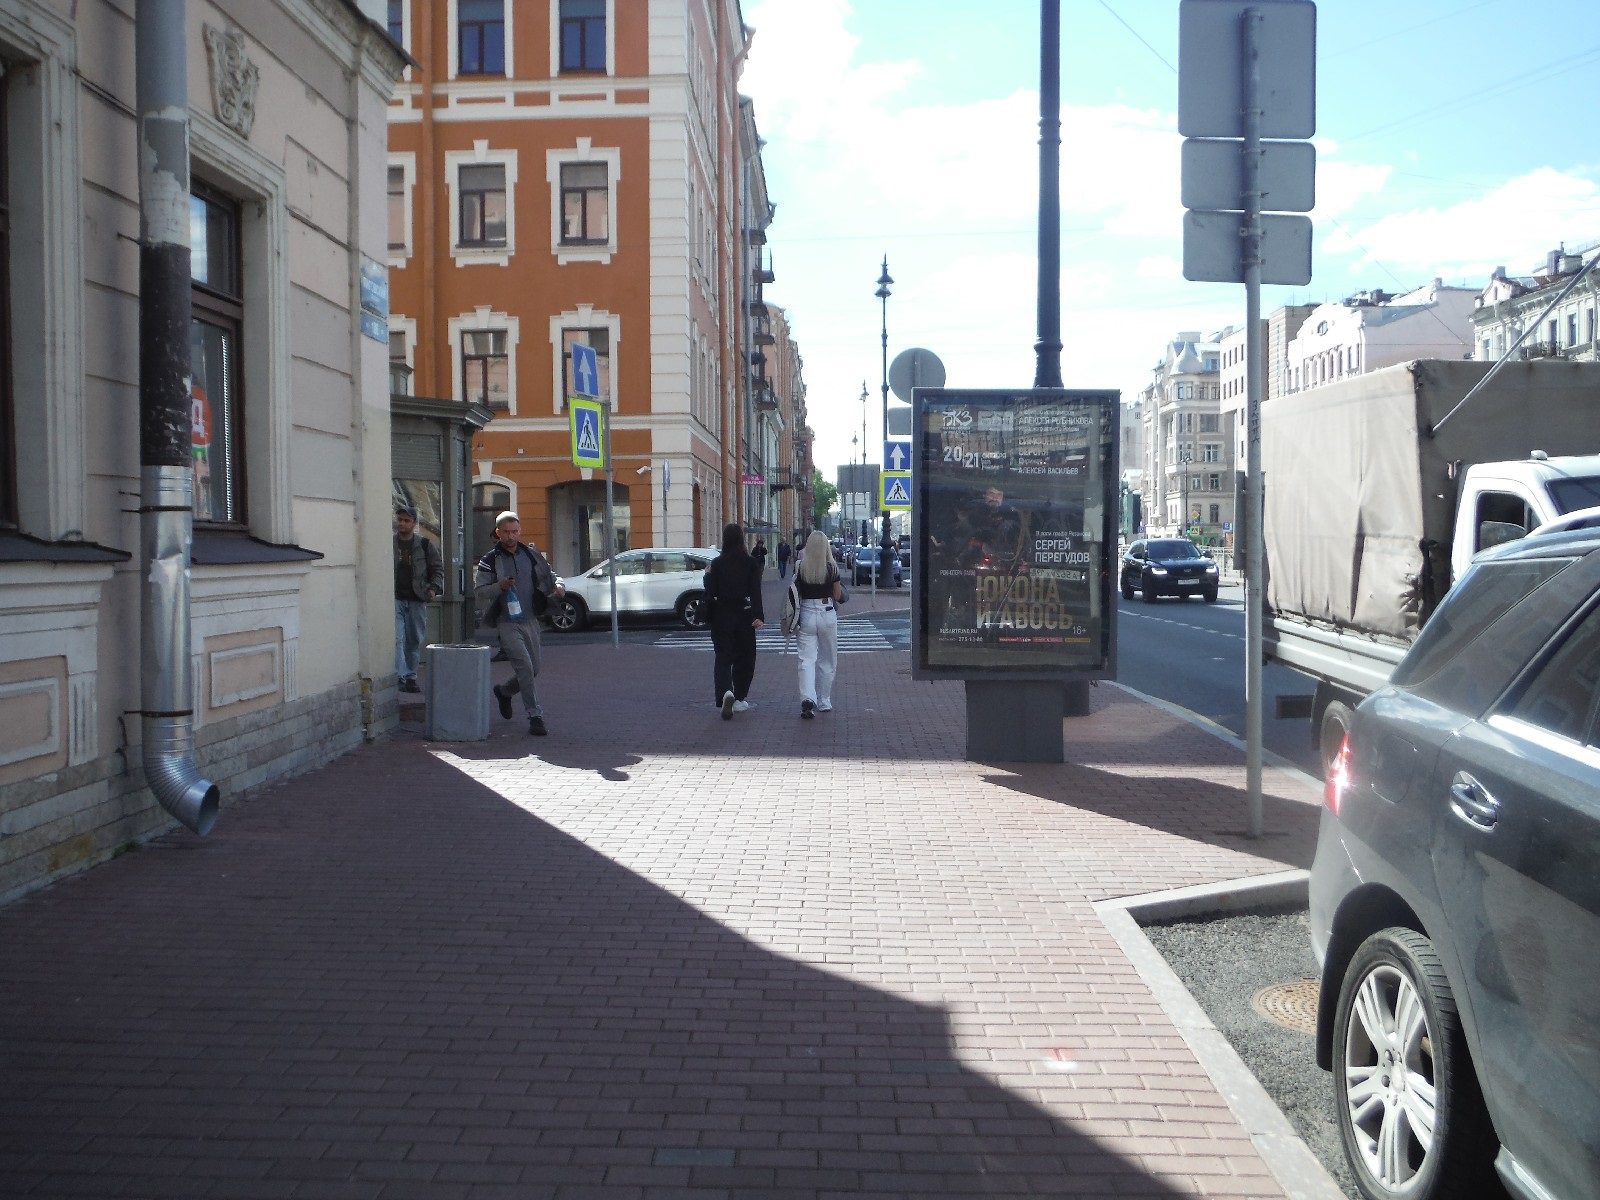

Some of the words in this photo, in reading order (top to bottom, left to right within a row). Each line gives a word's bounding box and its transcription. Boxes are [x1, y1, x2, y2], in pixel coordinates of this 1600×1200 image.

[943, 445, 962, 462] 20
[964, 452, 979, 468] 21
[1035, 537, 1071, 550] СЕРГЕЙ
[1035, 551, 1090, 564] ПЕРЕГУДОВ
[999, 602, 1073, 630] АВОСЬ
